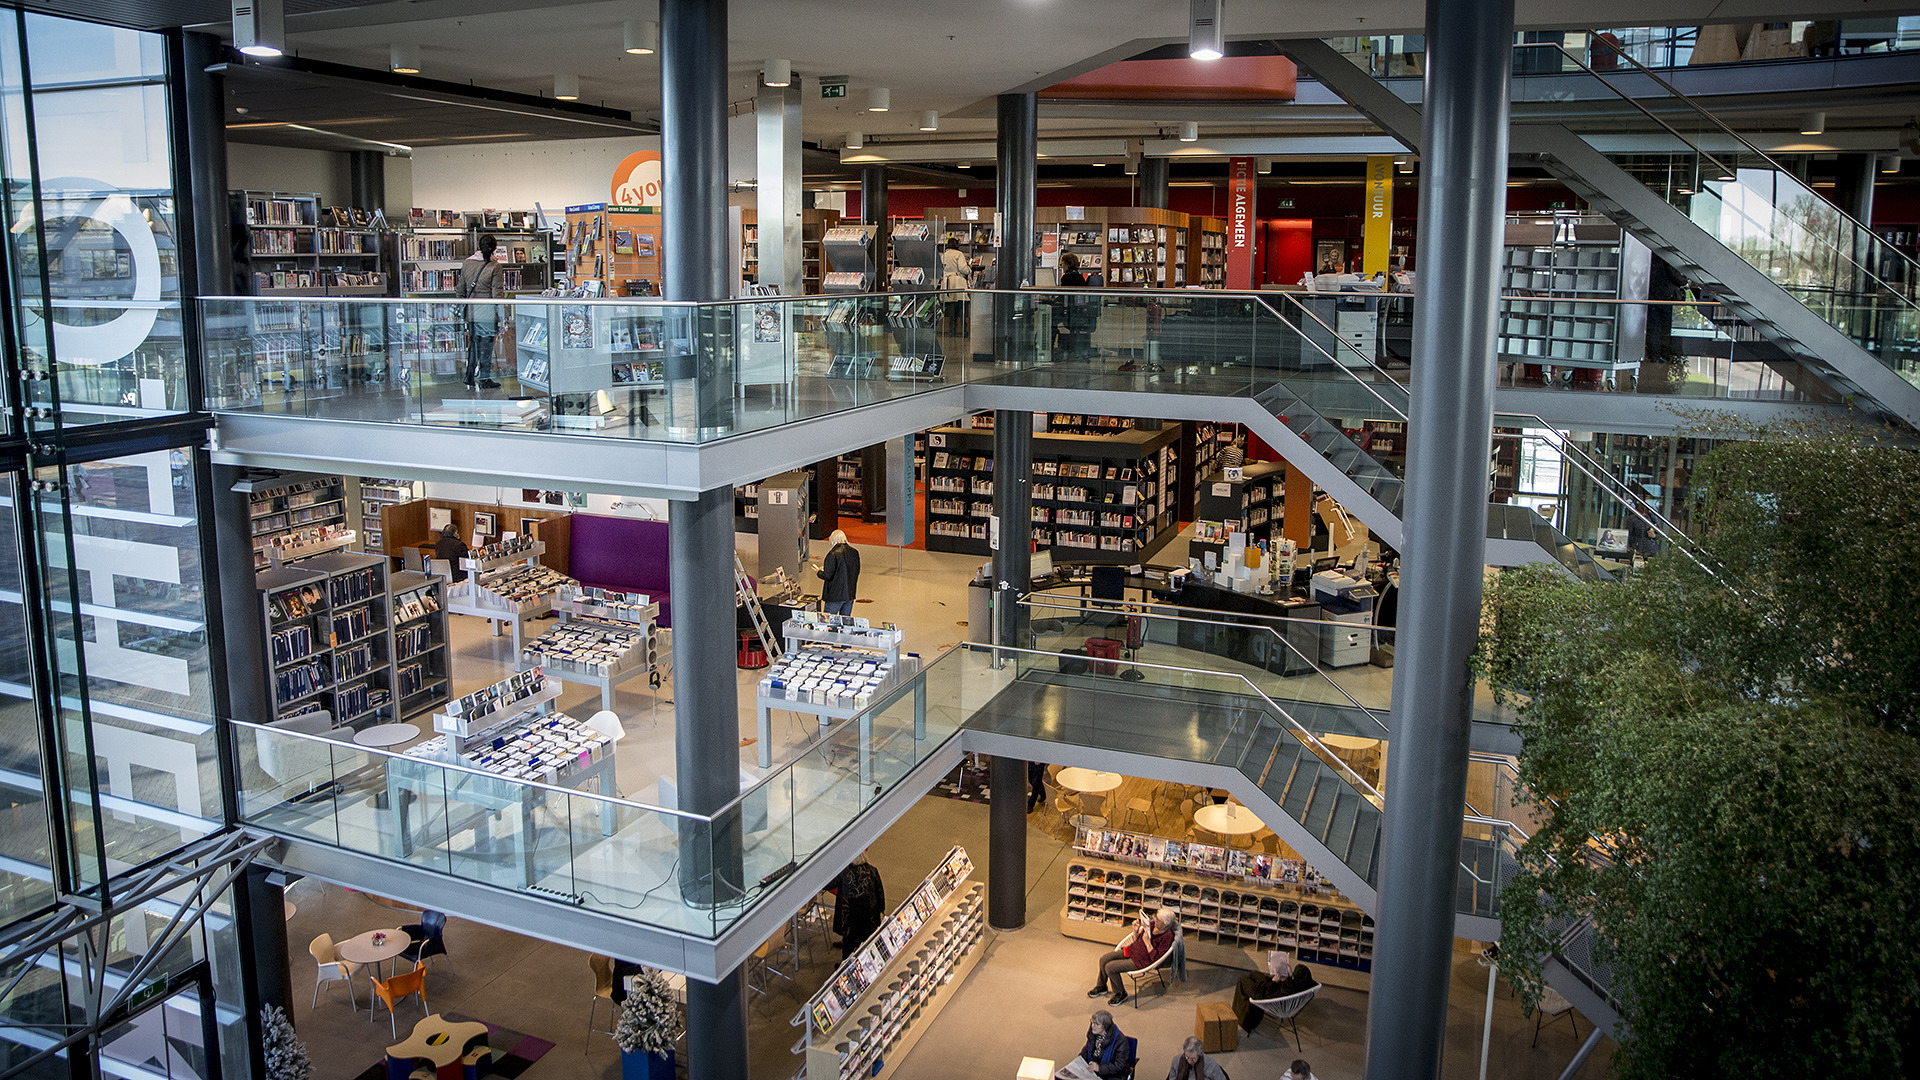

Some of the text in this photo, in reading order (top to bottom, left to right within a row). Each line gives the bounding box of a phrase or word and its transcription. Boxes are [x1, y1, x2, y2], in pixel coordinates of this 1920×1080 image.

[1234, 162, 1247, 248] FICTIE ALGEMEEN
[1372, 161, 1385, 219] AVONTUUR
